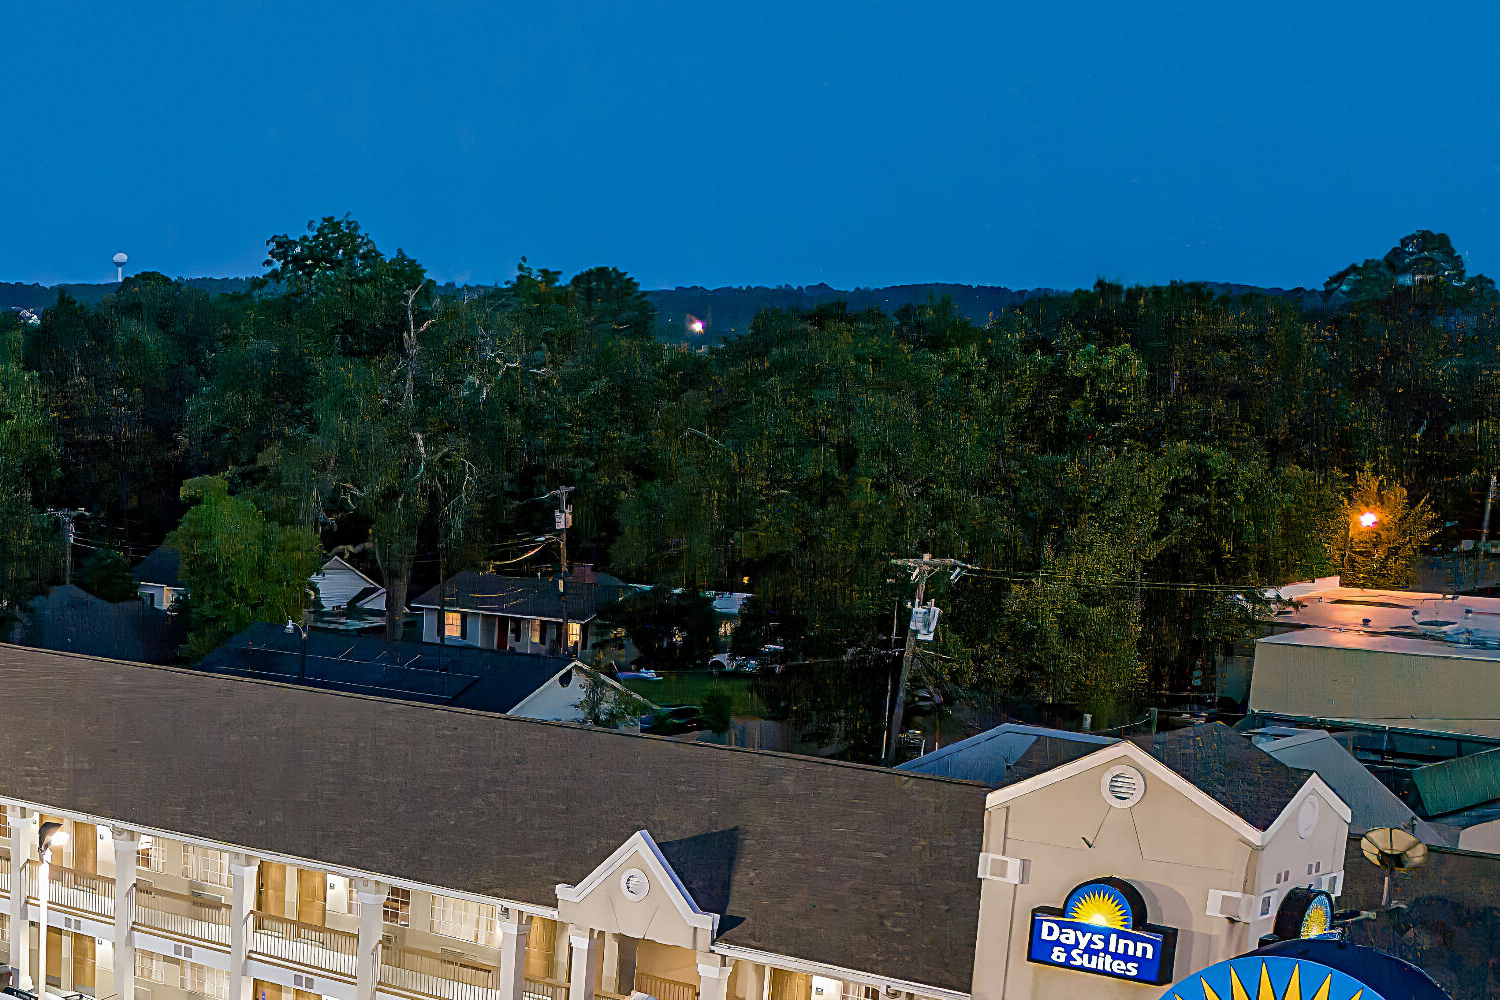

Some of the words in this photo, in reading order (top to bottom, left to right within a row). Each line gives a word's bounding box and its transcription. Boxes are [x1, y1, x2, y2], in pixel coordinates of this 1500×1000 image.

[1040, 920, 1105, 950] Days
[1108, 933, 1154, 959] Inn
[1050, 946, 1068, 963] &
[1069, 948, 1139, 976] Suites
